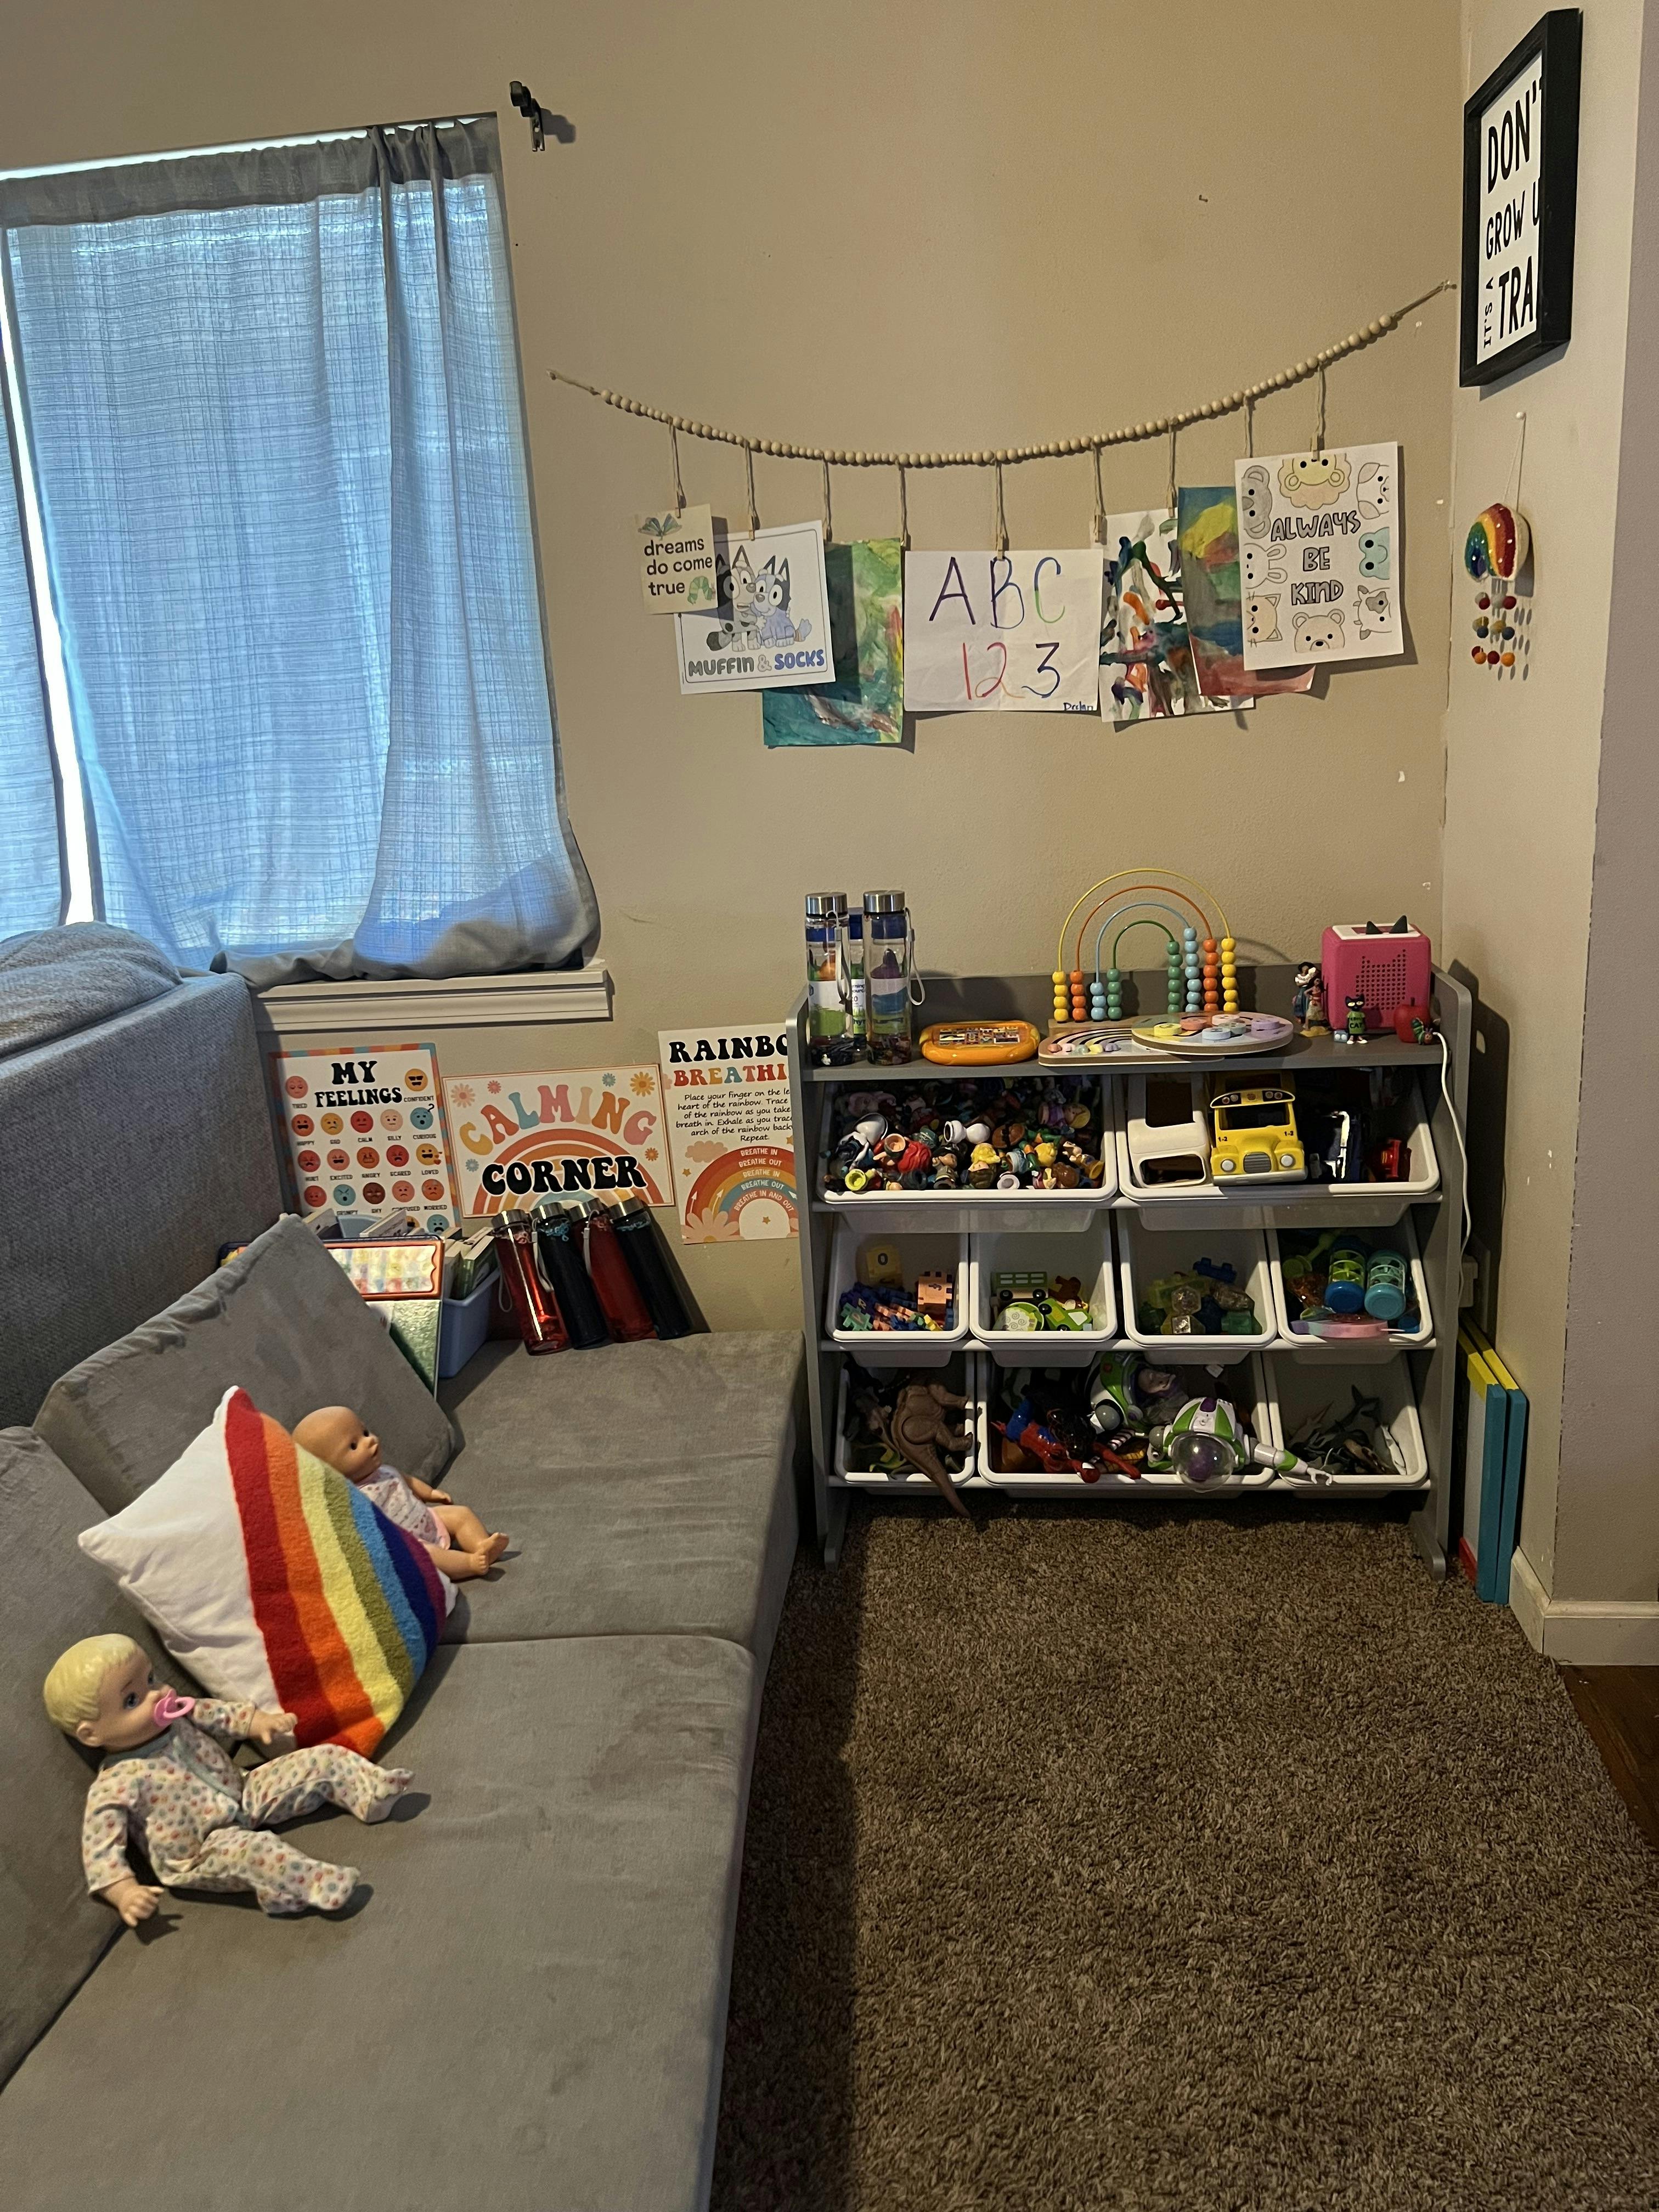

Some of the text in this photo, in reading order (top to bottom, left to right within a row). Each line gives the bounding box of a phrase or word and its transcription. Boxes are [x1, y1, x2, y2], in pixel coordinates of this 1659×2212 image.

[1488, 77, 1541, 194] DON'
[1486, 190, 1525, 259] GROW
[1484, 276, 1493, 348] IT'S A
[1271, 510, 1361, 541] ALWAYS
[644, 539, 704, 556] dreams
[647, 557, 713, 575] do come
[1303, 546, 1330, 572] BE
[648, 582, 685, 596] true
[757, 654, 772, 673] &
[774, 649, 825, 670] SOCKS
[331, 1060, 377, 1085] MY
[314, 1087, 402, 1107] FEELINGS
[708, 1093, 726, 1104] your
[729, 1091, 752, 1099] finger
[459, 1085, 657, 1155] CALMING
[684, 1111, 692, 1119] of
[710, 1109, 743, 1118] rainbow
[757, 1108, 771, 1116] you
[717, 1118, 743, 1126] Exhale
[712, 1127, 720, 1135] of
[737, 1125, 770, 1133] rainbow
[740, 1148, 769, 1157] BREATHE
[738, 1158, 782, 1168] BREATHE OUT
[482, 1156, 647, 1195] CORNER
[742, 1169, 771, 1178] BREATHE
[741, 1180, 785, 1191] BREATHE OUT
[733, 1190, 758, 1211] BREATHE
[769, 1191, 782, 1201] AND
[782, 1199, 794, 1211] OUT
